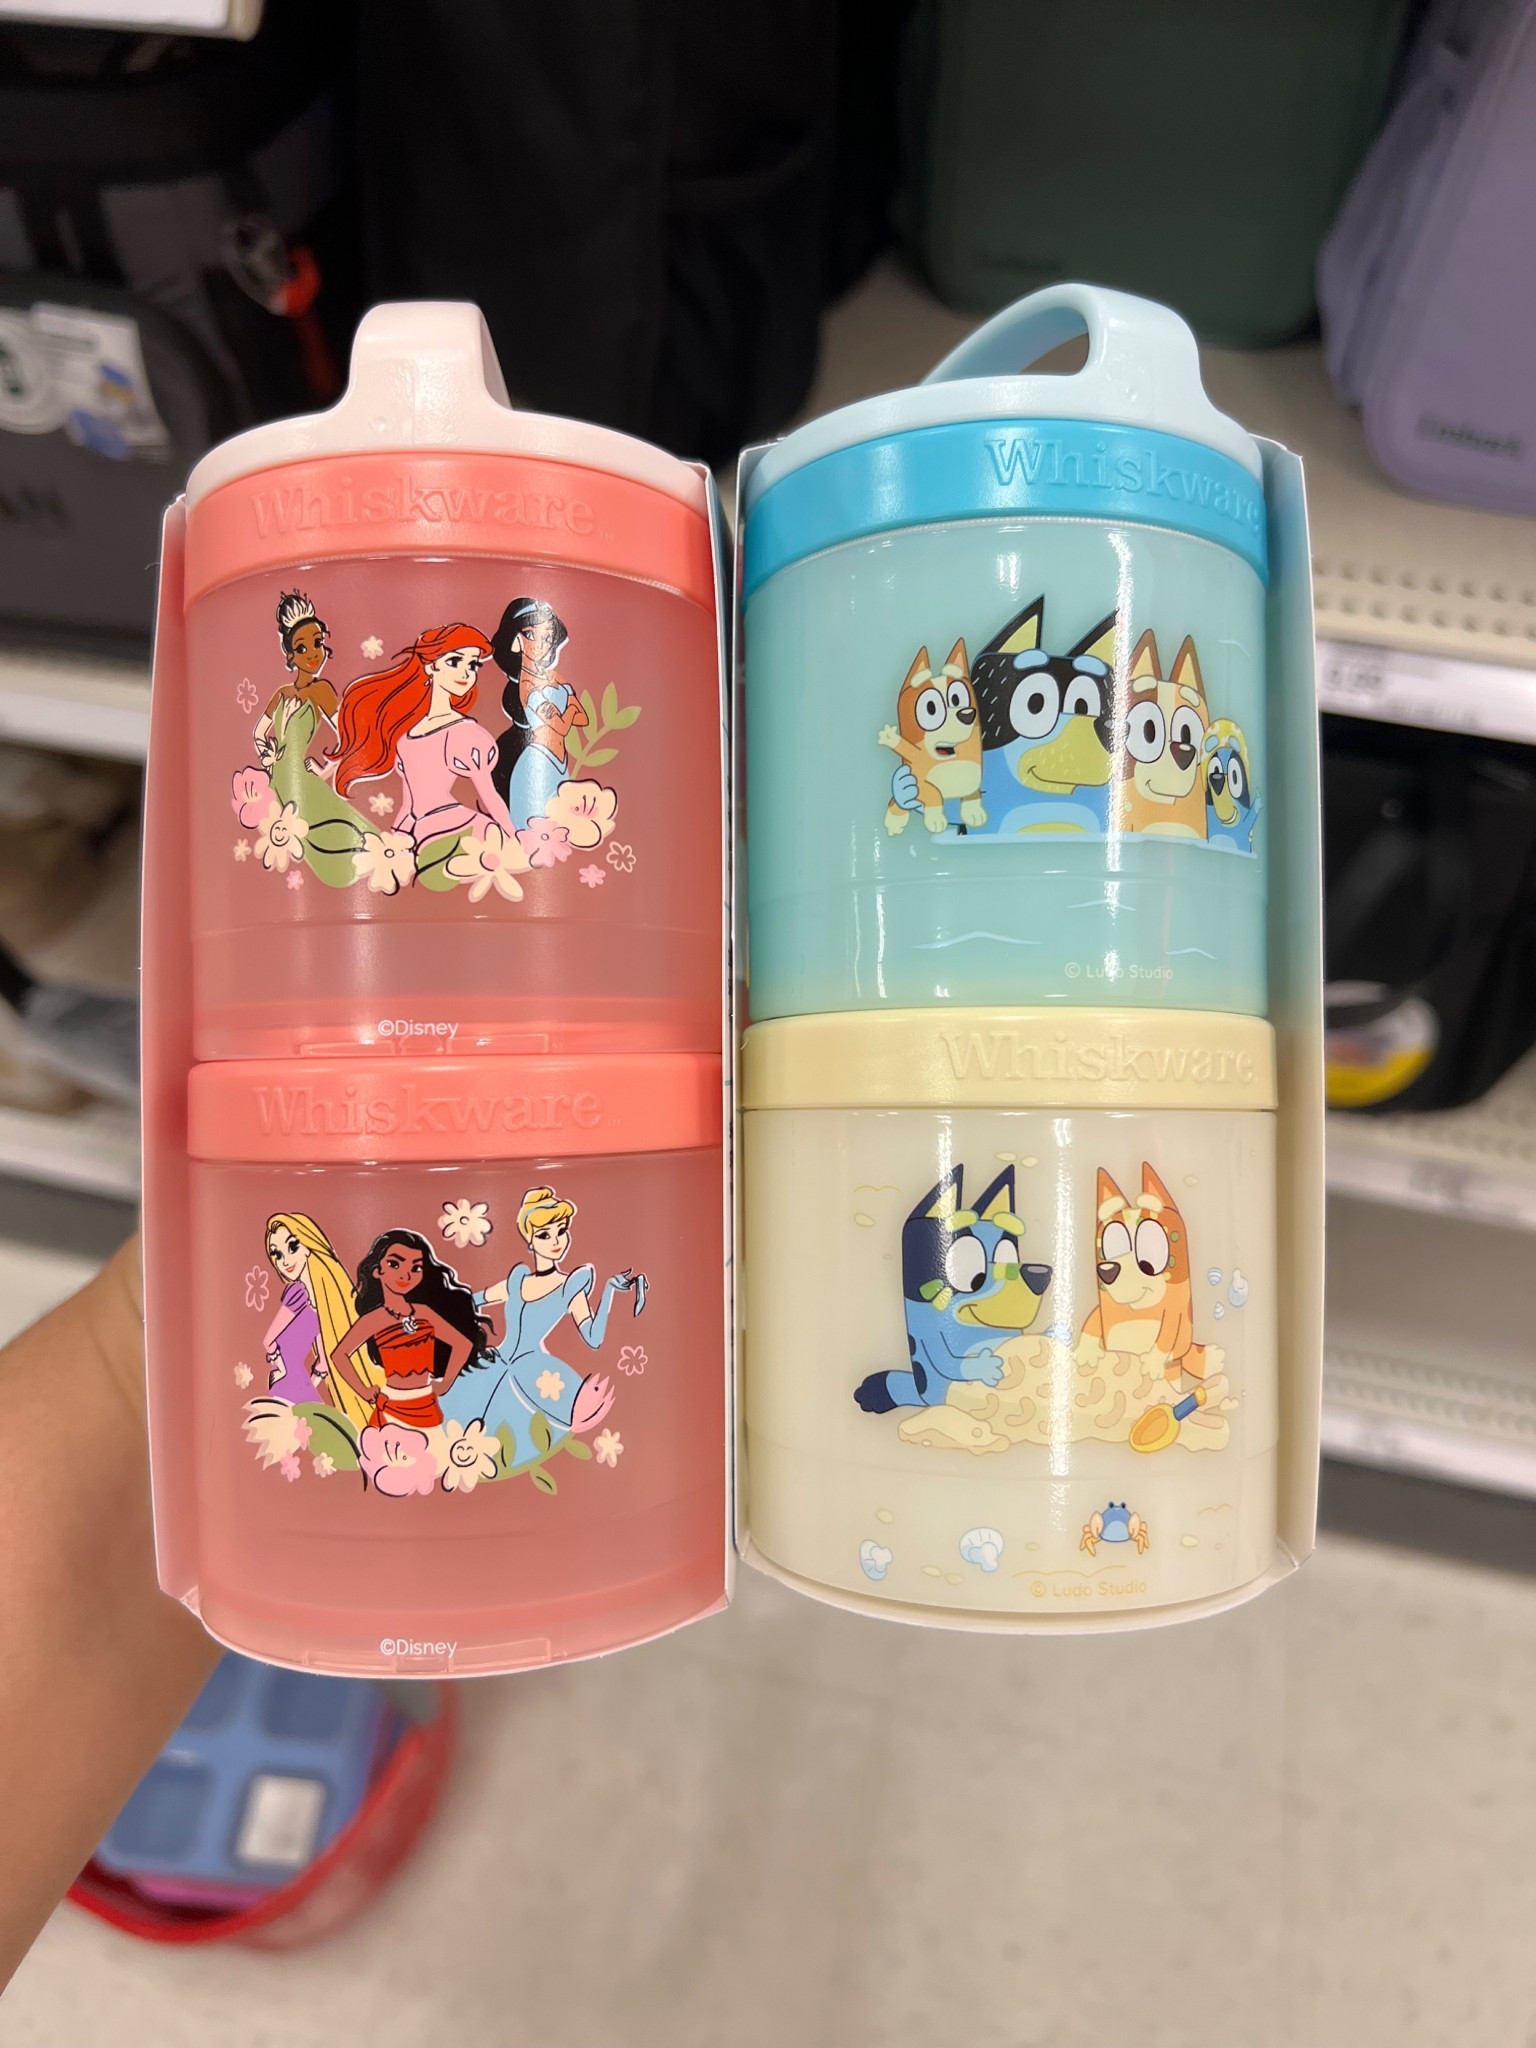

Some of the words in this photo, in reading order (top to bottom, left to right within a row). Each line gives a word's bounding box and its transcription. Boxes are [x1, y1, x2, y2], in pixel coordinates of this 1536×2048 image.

[250, 475, 595, 538] Whiskware
[984, 437, 1262, 523] Whiskware
[1086, 965, 1125, 979] Luo
[1129, 964, 1174, 980] Studio
[939, 1030, 1255, 1084] Whiskware
[252, 1083, 602, 1136] Whiskware
[1052, 1582, 1093, 1597] Ludo
[1098, 1579, 1148, 1596] Studio
